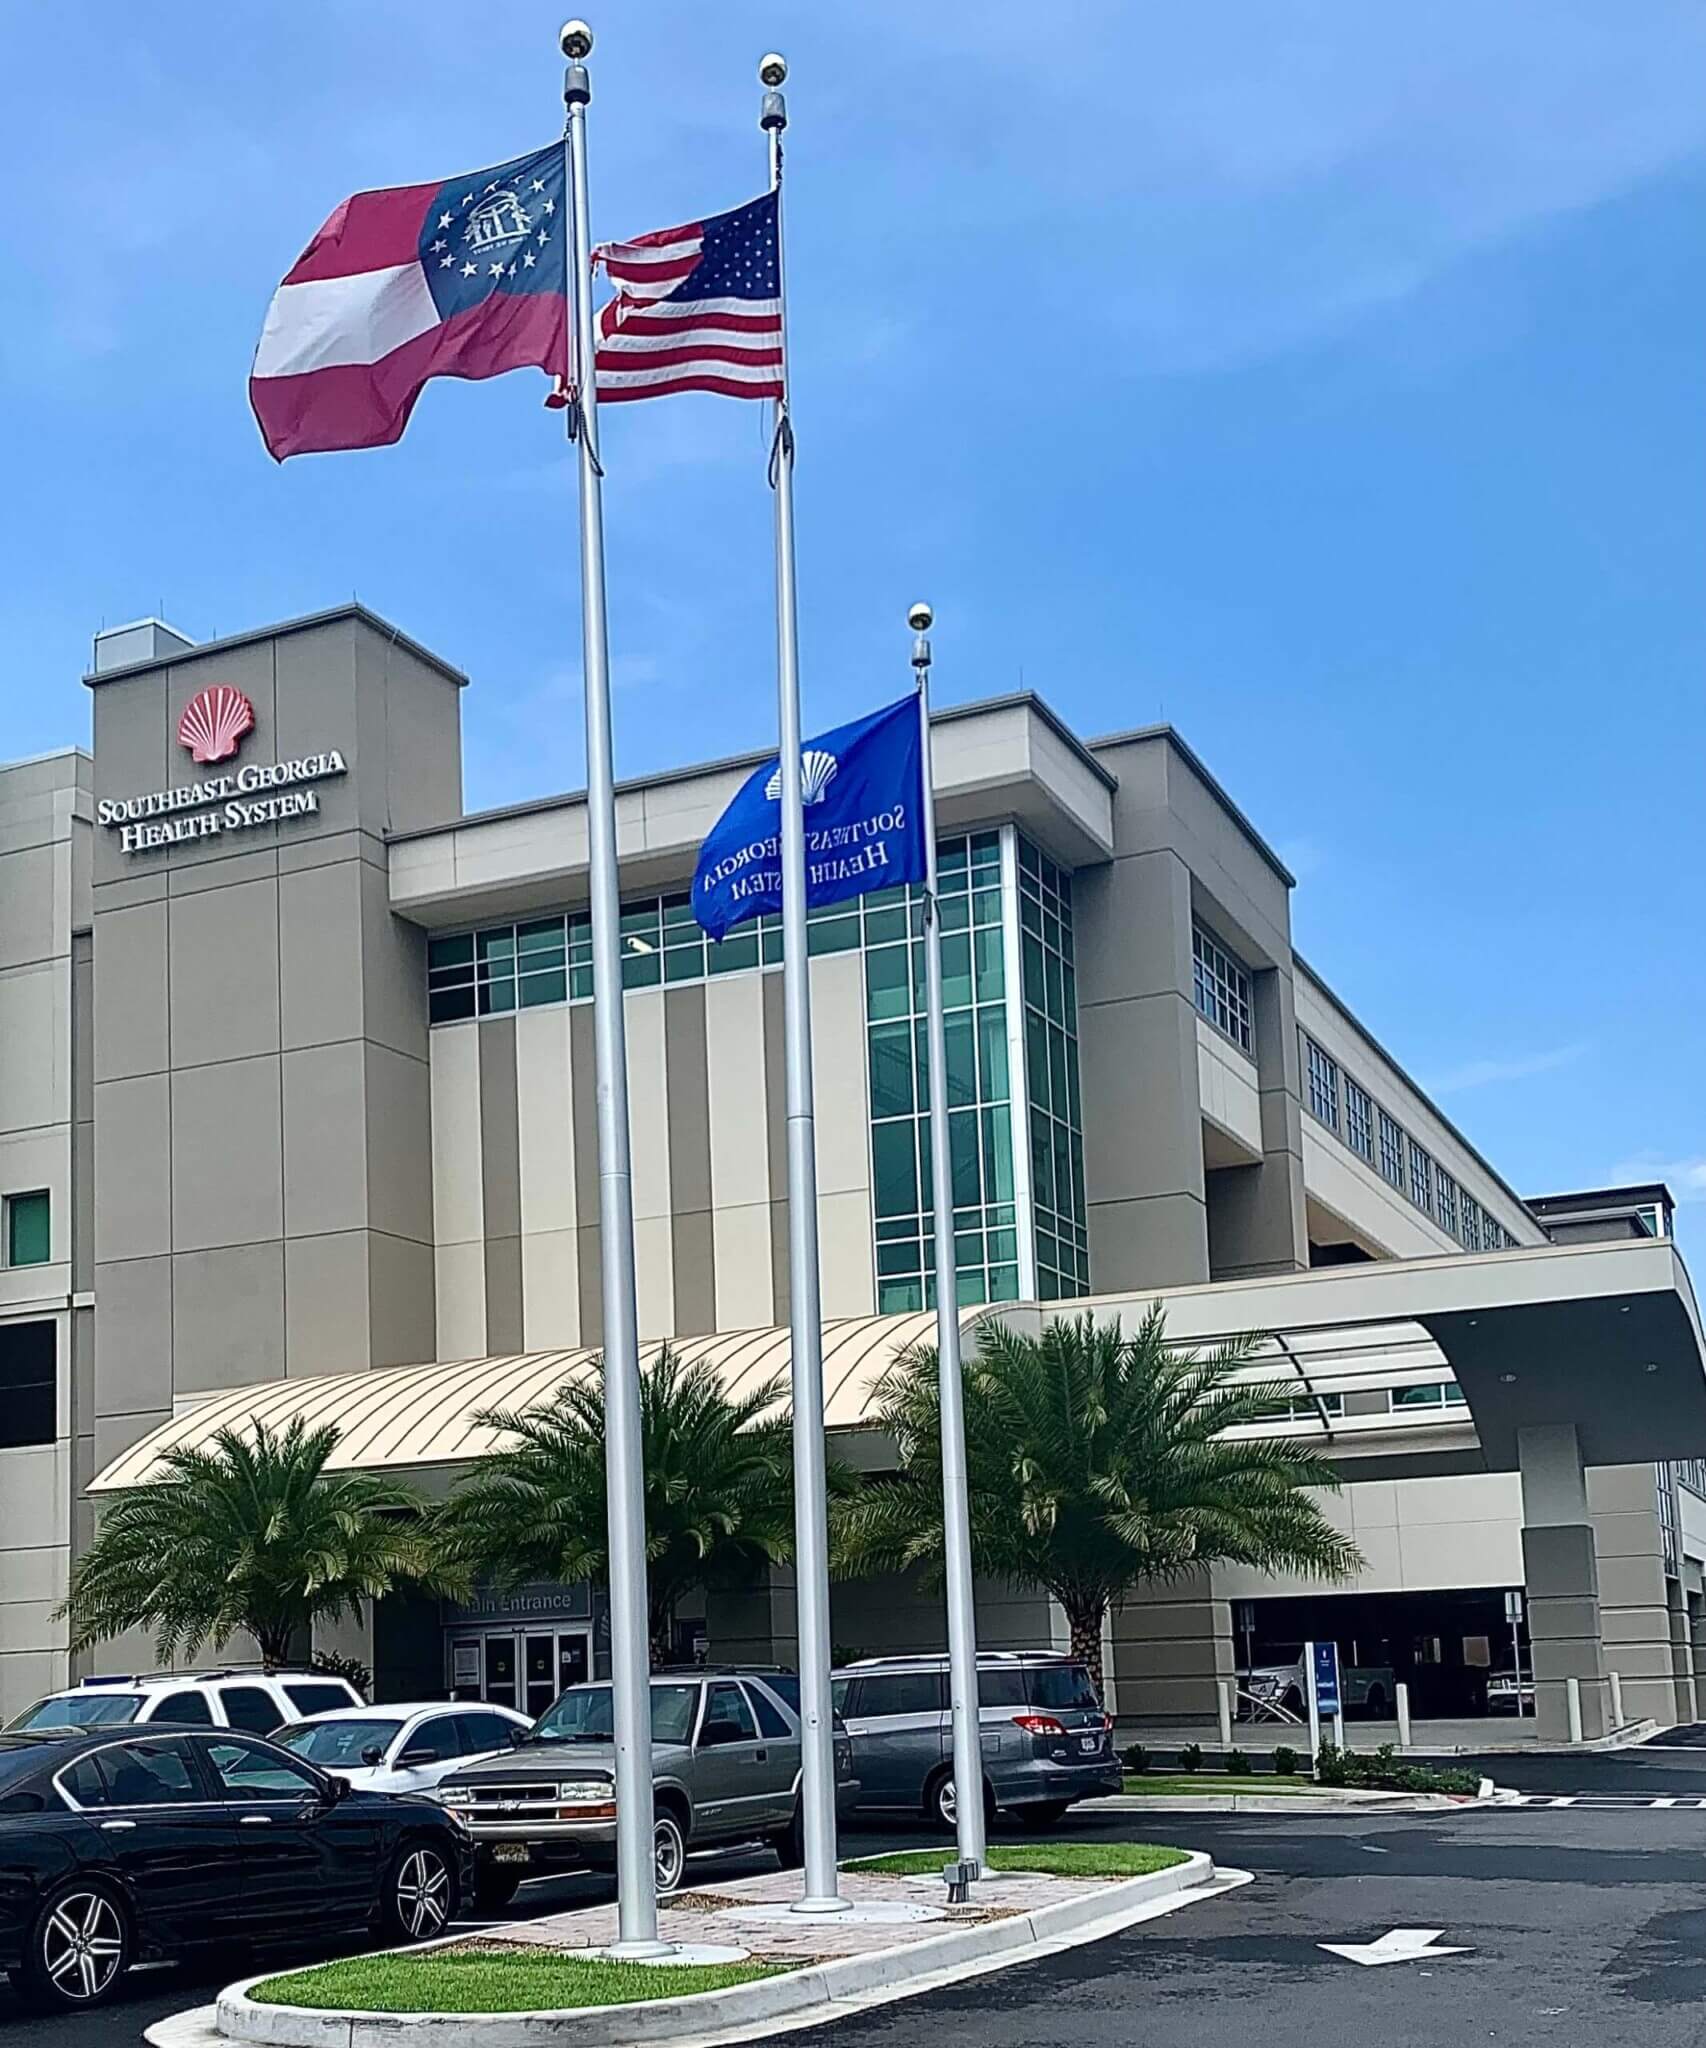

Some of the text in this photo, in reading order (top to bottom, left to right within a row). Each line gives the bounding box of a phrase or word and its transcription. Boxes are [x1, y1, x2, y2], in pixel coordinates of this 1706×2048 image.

[98, 749, 348, 826] SOUTHEAST GEORGIA
[120, 789, 318, 854] HEALTH SYSTEM
[501, 1593, 572, 1612] Entrance
